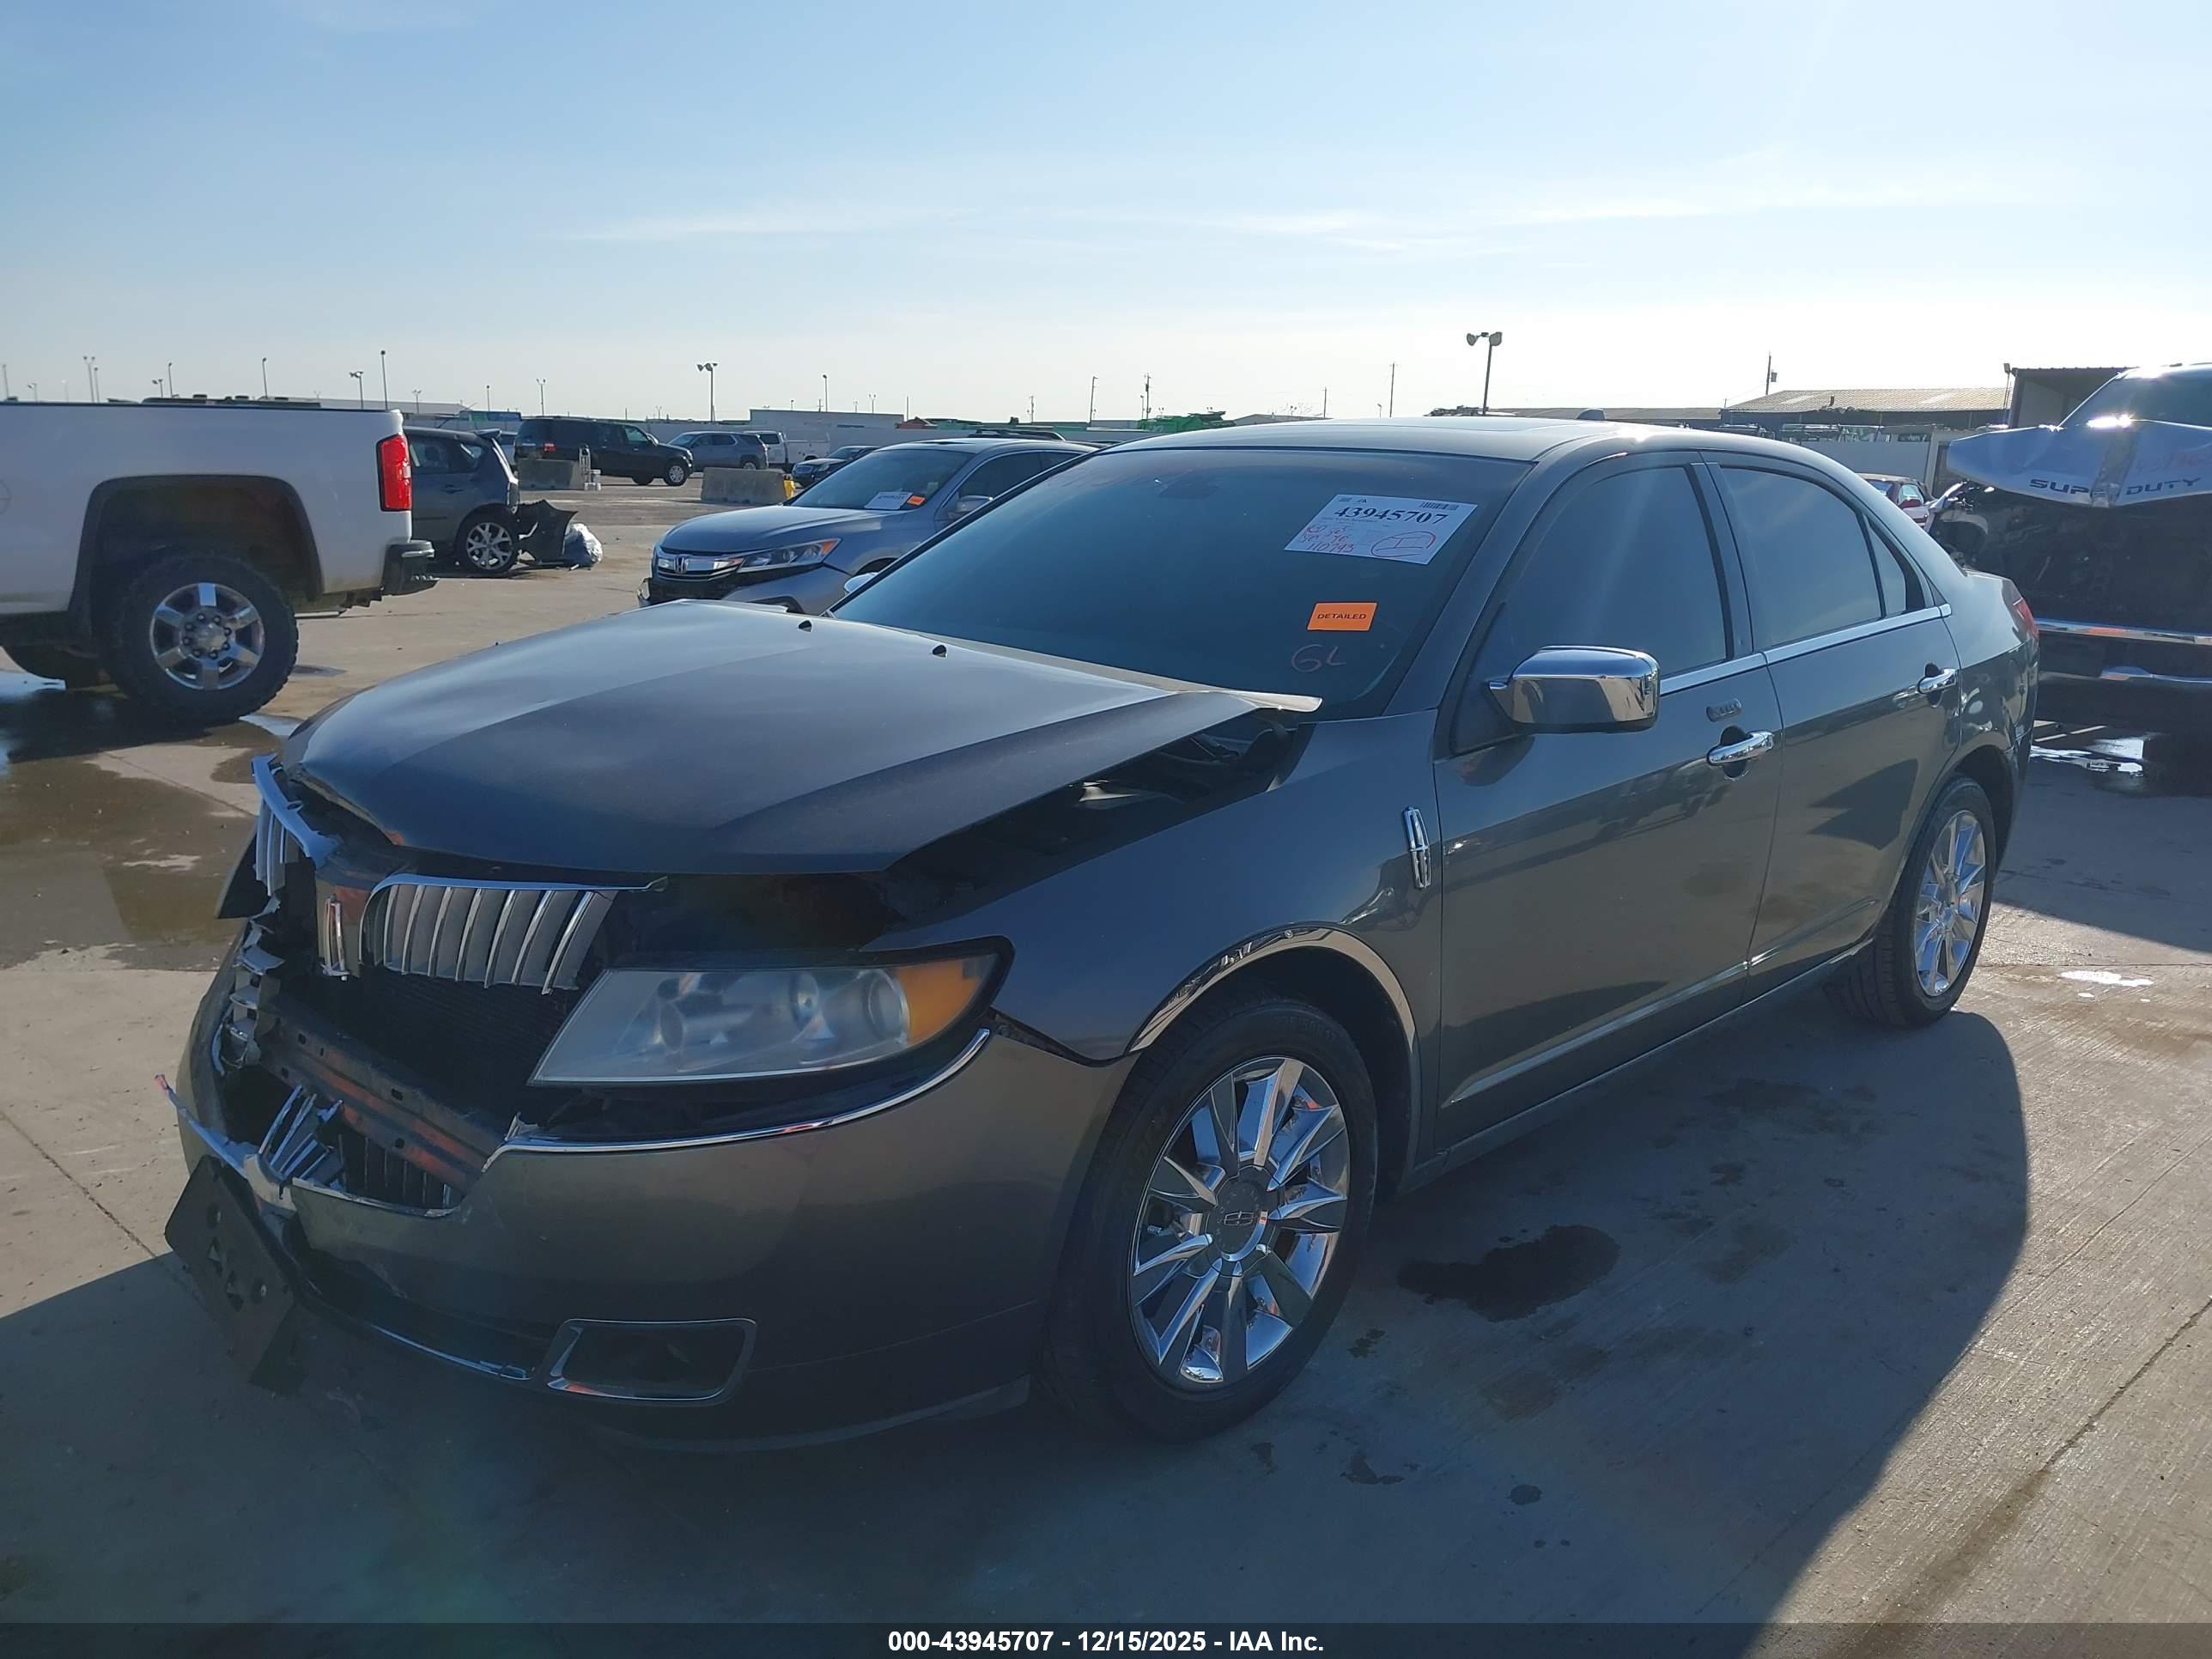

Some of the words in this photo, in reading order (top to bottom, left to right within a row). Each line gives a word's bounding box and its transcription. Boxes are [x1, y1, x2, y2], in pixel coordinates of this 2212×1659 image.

[2029, 478, 2104, 495] SUP
[2125, 477, 2201, 495] DUTY
[1334, 507, 1449, 525] 43945707
